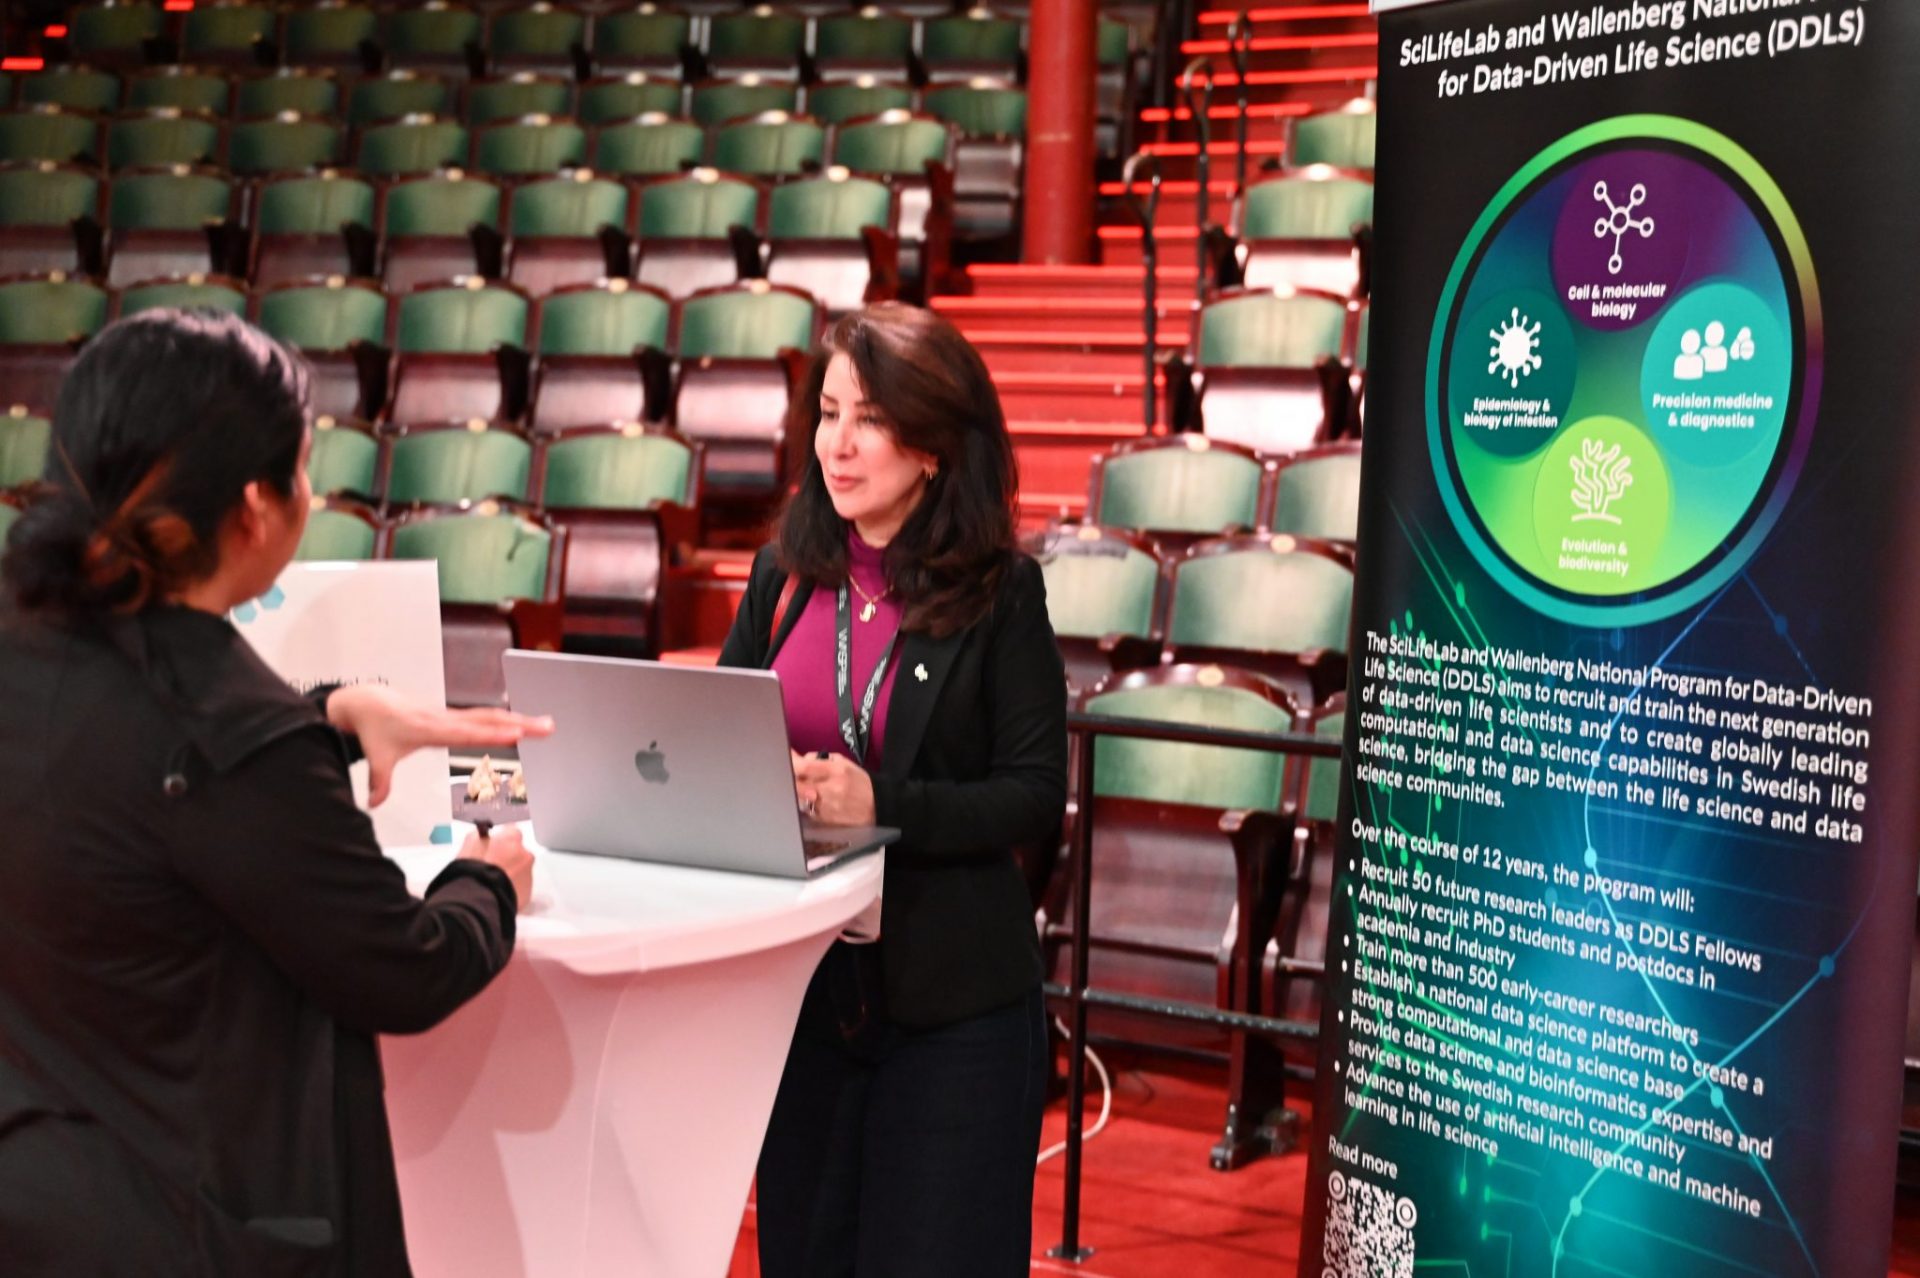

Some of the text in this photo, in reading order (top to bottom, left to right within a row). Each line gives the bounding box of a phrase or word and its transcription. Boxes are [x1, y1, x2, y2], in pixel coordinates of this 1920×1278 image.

[1400, 24, 1500, 67] SciLifeLab
[1505, 15, 1546, 50] and
[1552, 0, 1686, 42] Wallenberg
[1438, 6, 1864, 98] for Data-Driven Life Science (DDLS)
[1568, 282, 1666, 300] Cell & molecular
[1592, 300, 1636, 320] biology
[1464, 412, 1558, 430] biology of infection
[1474, 396, 1550, 414] Epidemiology &
[1653, 392, 1772, 409] Precision medicine
[1668, 411, 1754, 432] & diagnostics
[1559, 554, 1628, 578] biodiversity
[1562, 537, 1616, 554] Evolution
[1364, 657, 1870, 748] Life Science (DDLS) aims to recruit and train the next generation
[1367, 631, 1872, 717] The SciLifeLab and Wallenberg National Program for Data-Driven
[1360, 712, 1866, 811] computational and data science capabilities in Swedish life
[1362, 683, 1868, 784] of data-driven life scientists and to create globally leading
[1357, 762, 1504, 807] science communities.
[1359, 735, 1863, 843] science, bridging the gap between the life science and data
[1352, 818, 1694, 912] Over the course of 12 years, the program will:
[1357, 913, 1515, 970] academia and industry
[1359, 884, 1715, 990] Annually recruit PhD students and postdocs in
[1361, 857, 1761, 972] Recruit 50 future research leaders as DDLS Fellows
[1354, 959, 1764, 1095] Establish a national data science platform to create a
[1356, 933, 1698, 1046] Train more than 500 early-career researchers
[1350, 1009, 1772, 1159] Provide data science and bioinformatics expertise and
[1352, 988, 1685, 1101] strong computational and data science base
[1344, 1086, 1498, 1156] learning in life science
[1346, 1061, 1761, 1217] Advance the use of artificial intelligence and machine
[1348, 1039, 1685, 1164] services to the Swedish research community
[1328, 1135, 1398, 1178] Read more
